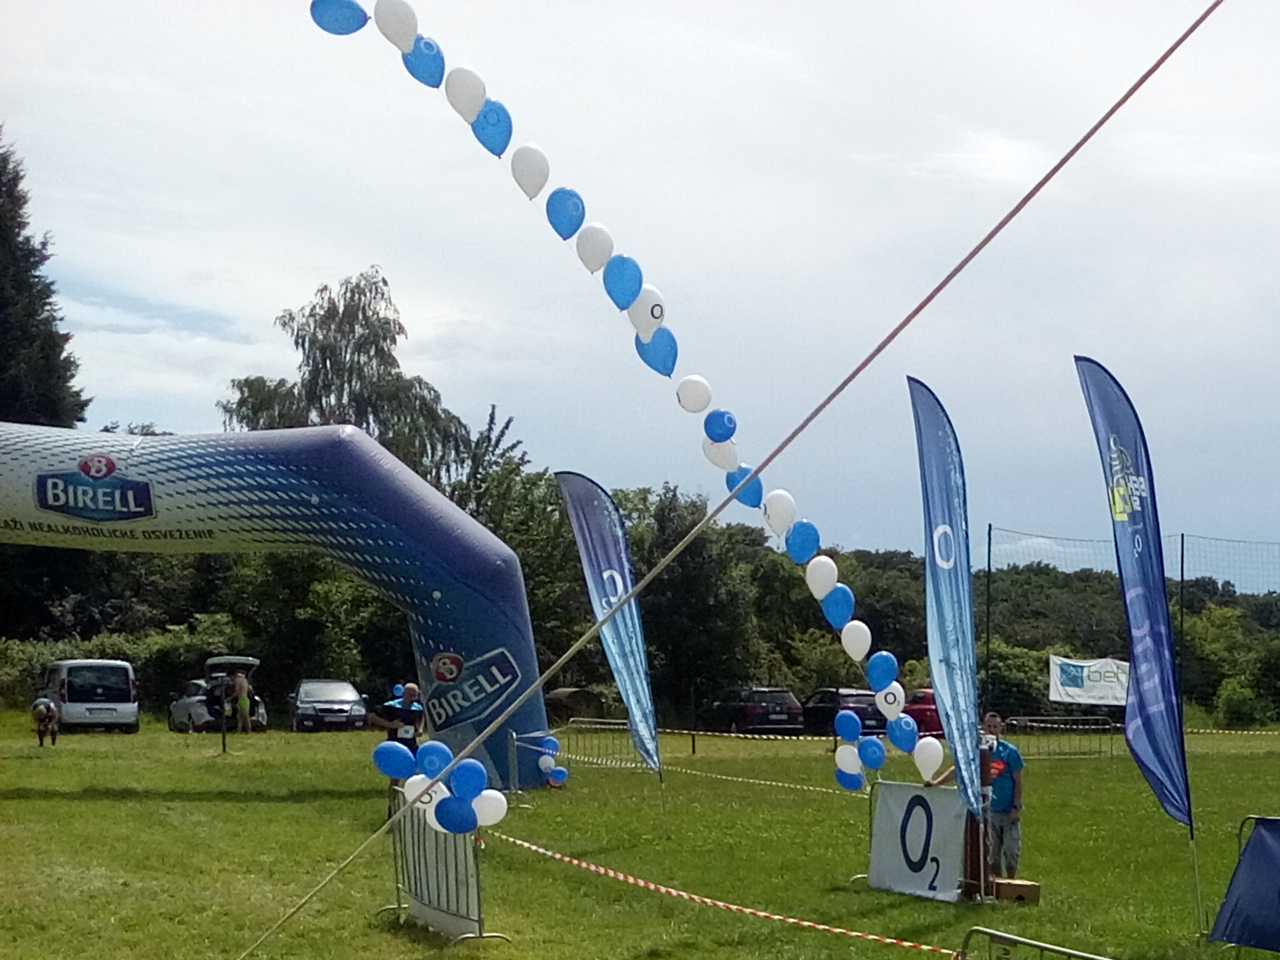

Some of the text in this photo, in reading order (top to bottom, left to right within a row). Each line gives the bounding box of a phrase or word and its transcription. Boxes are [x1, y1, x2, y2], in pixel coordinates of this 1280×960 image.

[46, 478, 145, 512] BIRELL
[428, 665, 513, 726] BIRELL
[900, 794, 940, 891] O2
